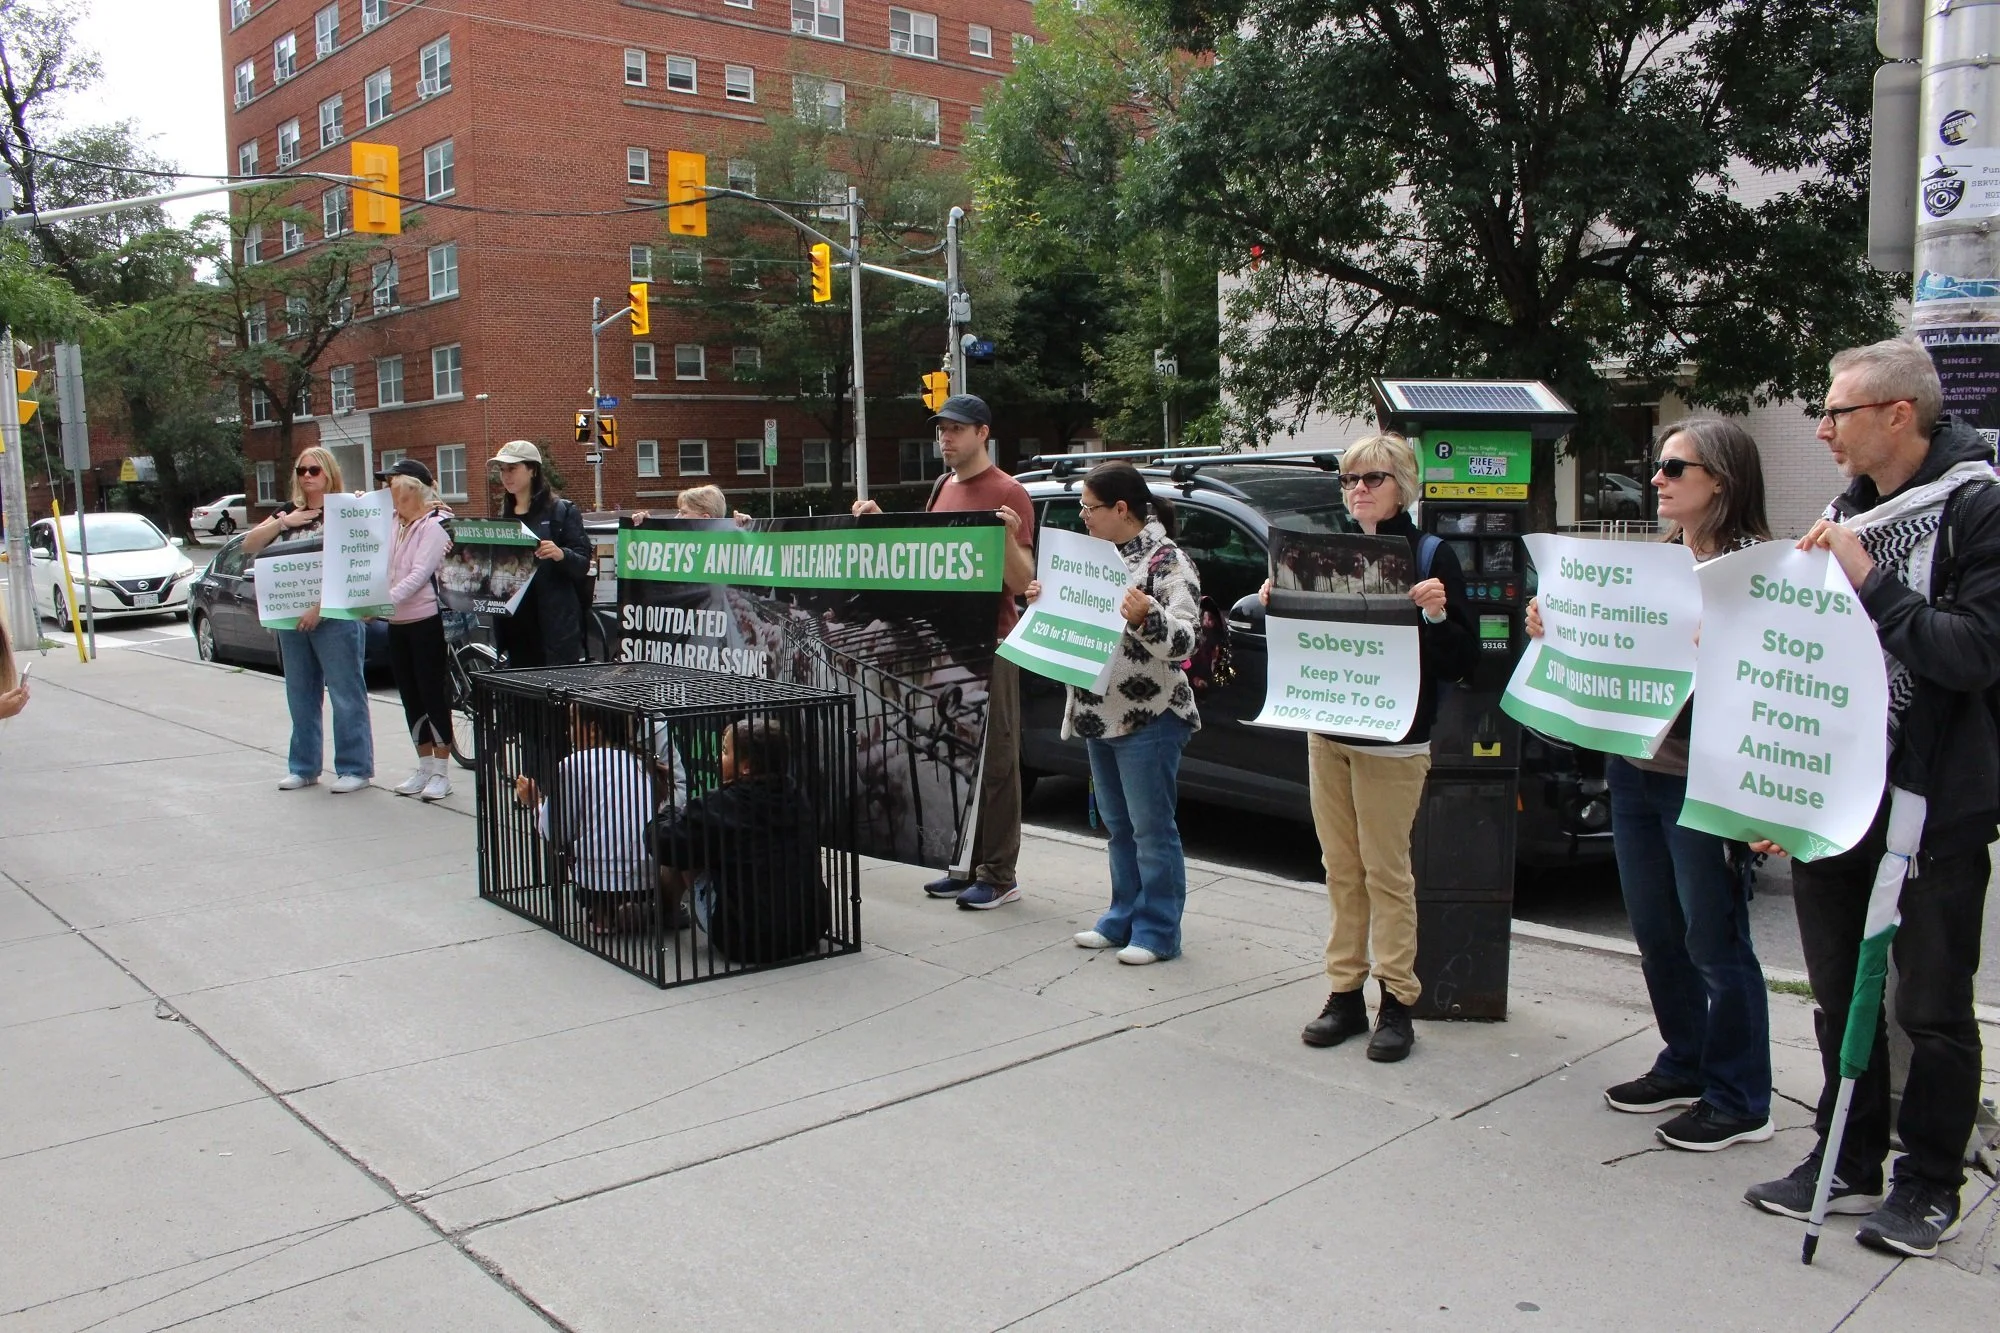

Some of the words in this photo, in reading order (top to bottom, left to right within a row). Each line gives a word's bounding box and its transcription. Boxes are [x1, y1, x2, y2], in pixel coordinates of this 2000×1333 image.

[1926, 180, 1961, 193] POLICE
[1469, 457, 1493, 466] FREE
[1469, 466, 1502, 475] GAZA
[340, 507, 381, 519] Sobeys:
[350, 528, 369, 538] Stop
[454, 526, 483, 538] SOBEYS:
[484, 528, 494, 538] GO
[341, 542, 380, 554] Profiting
[704, 544, 774, 577] ANIMAL
[780, 543, 842, 578] WELFARE
[846, 541, 984, 581] PRACTICES:
[272, 560, 323, 573] Sobeys:
[350, 559, 370, 568] From
[1051, 554, 1082, 575] Brave
[1084, 562, 1100, 579] the
[1102, 566, 1127, 587] Cage
[1560, 556, 1632, 588] Sobeys:
[275, 580, 298, 589] Keep
[300, 578, 322, 586] Your
[346, 572, 372, 584] Animal
[268, 590, 306, 600] Promise
[310, 588, 320, 596] To
[348, 588, 370, 598] Abuse
[1059, 585, 1115, 613] Challenge!
[1750, 574, 1852, 615] Sobeys:
[265, 602, 290, 612] 100%
[1546, 593, 1586, 618] Canadian
[1590, 603, 1668, 626] Families
[622, 604, 643, 630] SO
[646, 606, 728, 638] OUTDATED
[1032, 620, 1050, 637] $20
[1050, 627, 1061, 640] for
[1062, 628, 1067, 642] 5
[1066, 630, 1095, 649] Minutes
[1096, 638, 1103, 650] in
[1104, 642, 1108, 652] a
[1298, 632, 1384, 657] Sobeys:
[1556, 624, 1576, 642] want
[1580, 630, 1609, 647] you
[1614, 632, 1635, 650] to
[1762, 629, 1824, 664] Stop
[620, 638, 643, 663] SO
[645, 640, 768, 679] EMBARRASSING
[1300, 664, 1338, 684] Keep
[1344, 668, 1380, 686] Your
[1546, 659, 1566, 685] STOP
[1566, 669, 1622, 700] ABUSING
[1628, 680, 1675, 706] HENS
[1736, 660, 1849, 708] Profiting
[1286, 684, 1346, 704] Promise
[1350, 692, 1370, 707] To
[1374, 694, 1396, 710] Go
[1272, 704, 1312, 720] 100%
[1315, 710, 1401, 731] Cage-Free!
[1752, 700, 1820, 737] From
[1737, 735, 1832, 776] Animal
[1739, 771, 1825, 810] Abuse
